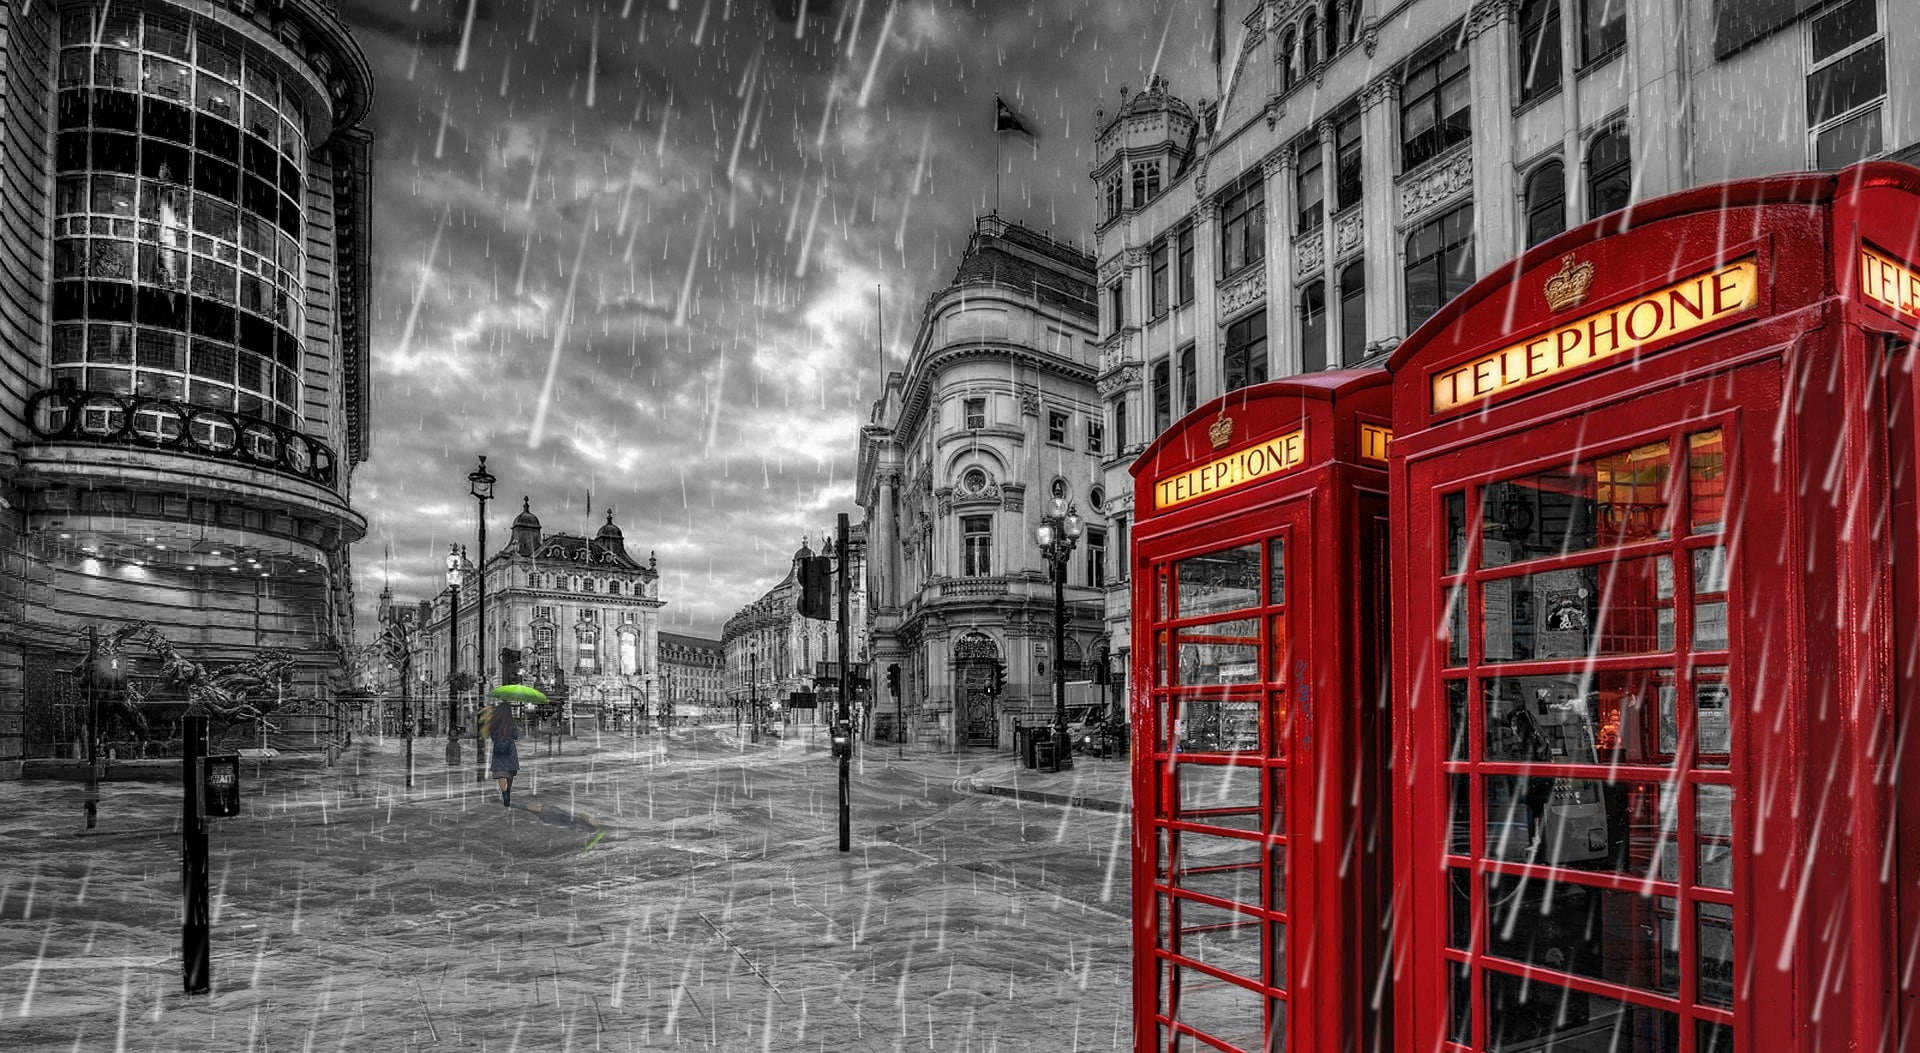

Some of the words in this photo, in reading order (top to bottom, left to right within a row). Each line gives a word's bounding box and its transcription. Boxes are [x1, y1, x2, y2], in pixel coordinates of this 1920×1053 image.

[1441, 265, 1744, 405] TELEPHONE
[1160, 435, 1300, 505] TELEPHONE
[210, 774, 234, 784] WAIT
